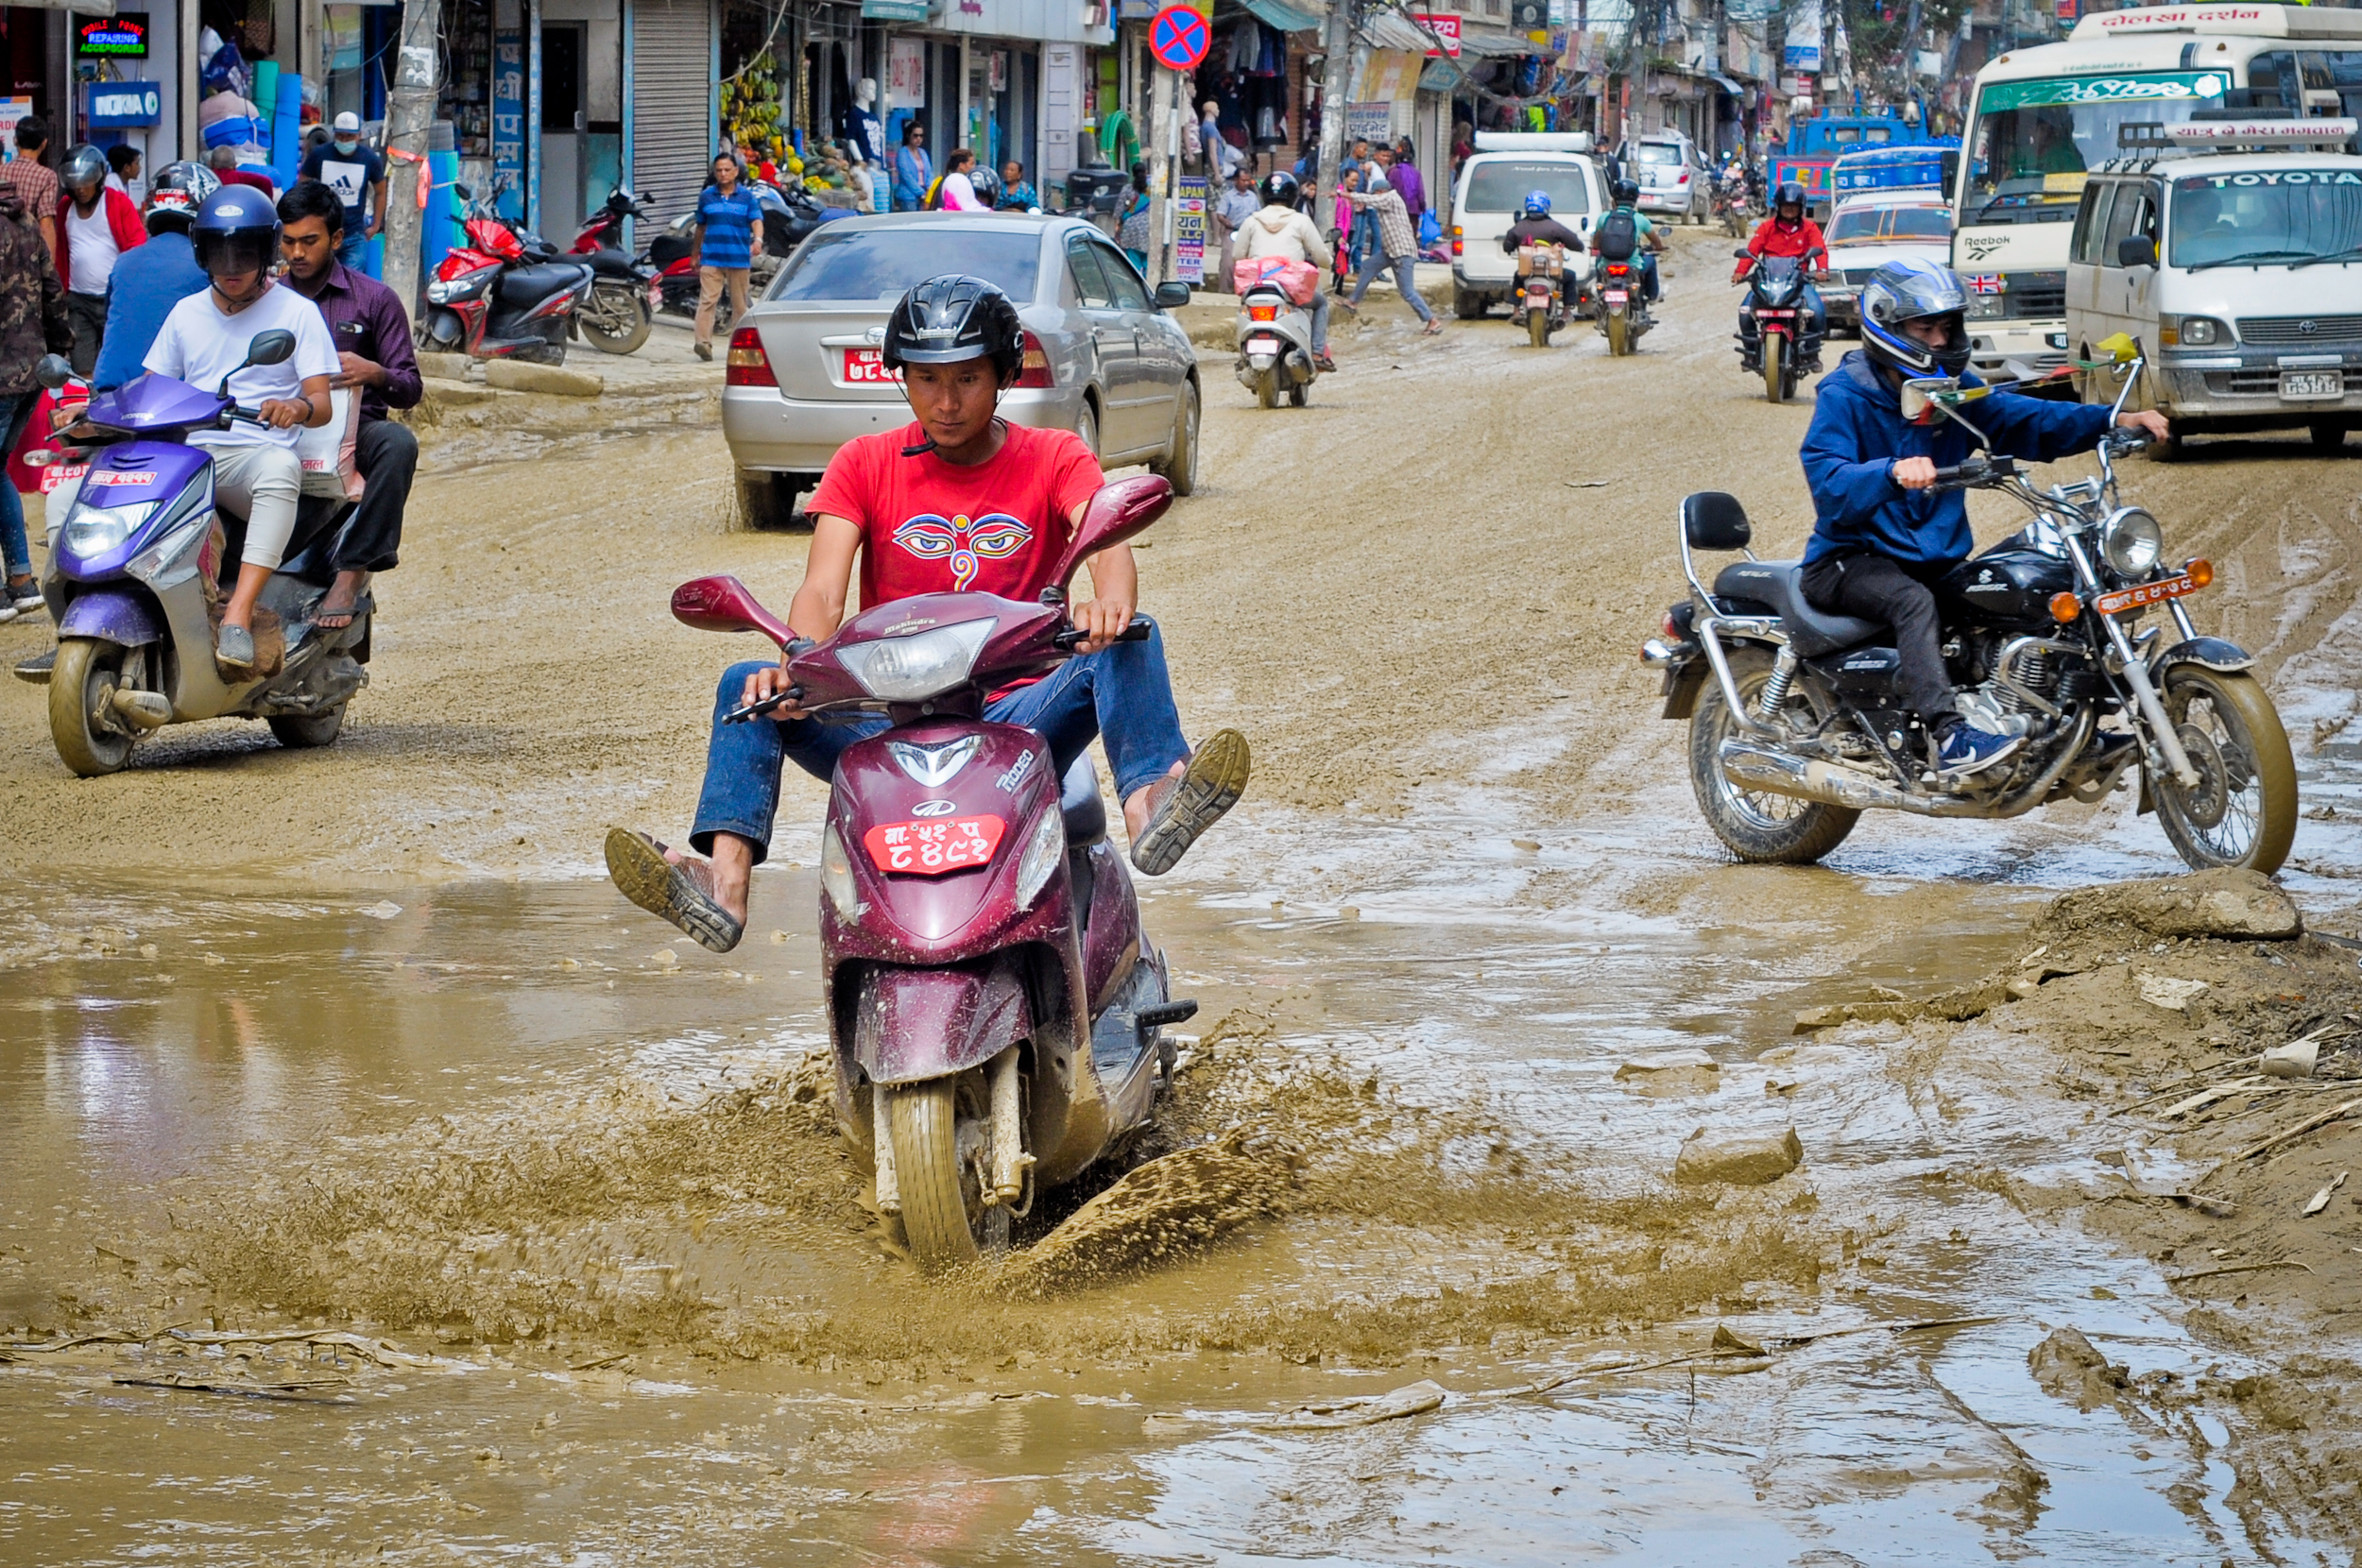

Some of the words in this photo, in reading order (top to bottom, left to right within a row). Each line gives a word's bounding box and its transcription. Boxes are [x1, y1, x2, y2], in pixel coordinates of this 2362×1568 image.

[80, 19, 109, 36] MOBILE
[118, 20, 145, 36] PHONE
[1422, 20, 1457, 34] ZZA
[88, 32, 140, 44] REPAIRING
[79, 43, 145, 53] ACCESSORIES
[95, 94, 144, 115] NOKIA
[2208, 171, 2362, 188] TOYOTA
[1179, 186, 1206, 197] APAN
[1178, 216, 1203, 229] यन
[1965, 235, 2011, 247] Reebok
[883, 617, 936, 635] Mahindra
